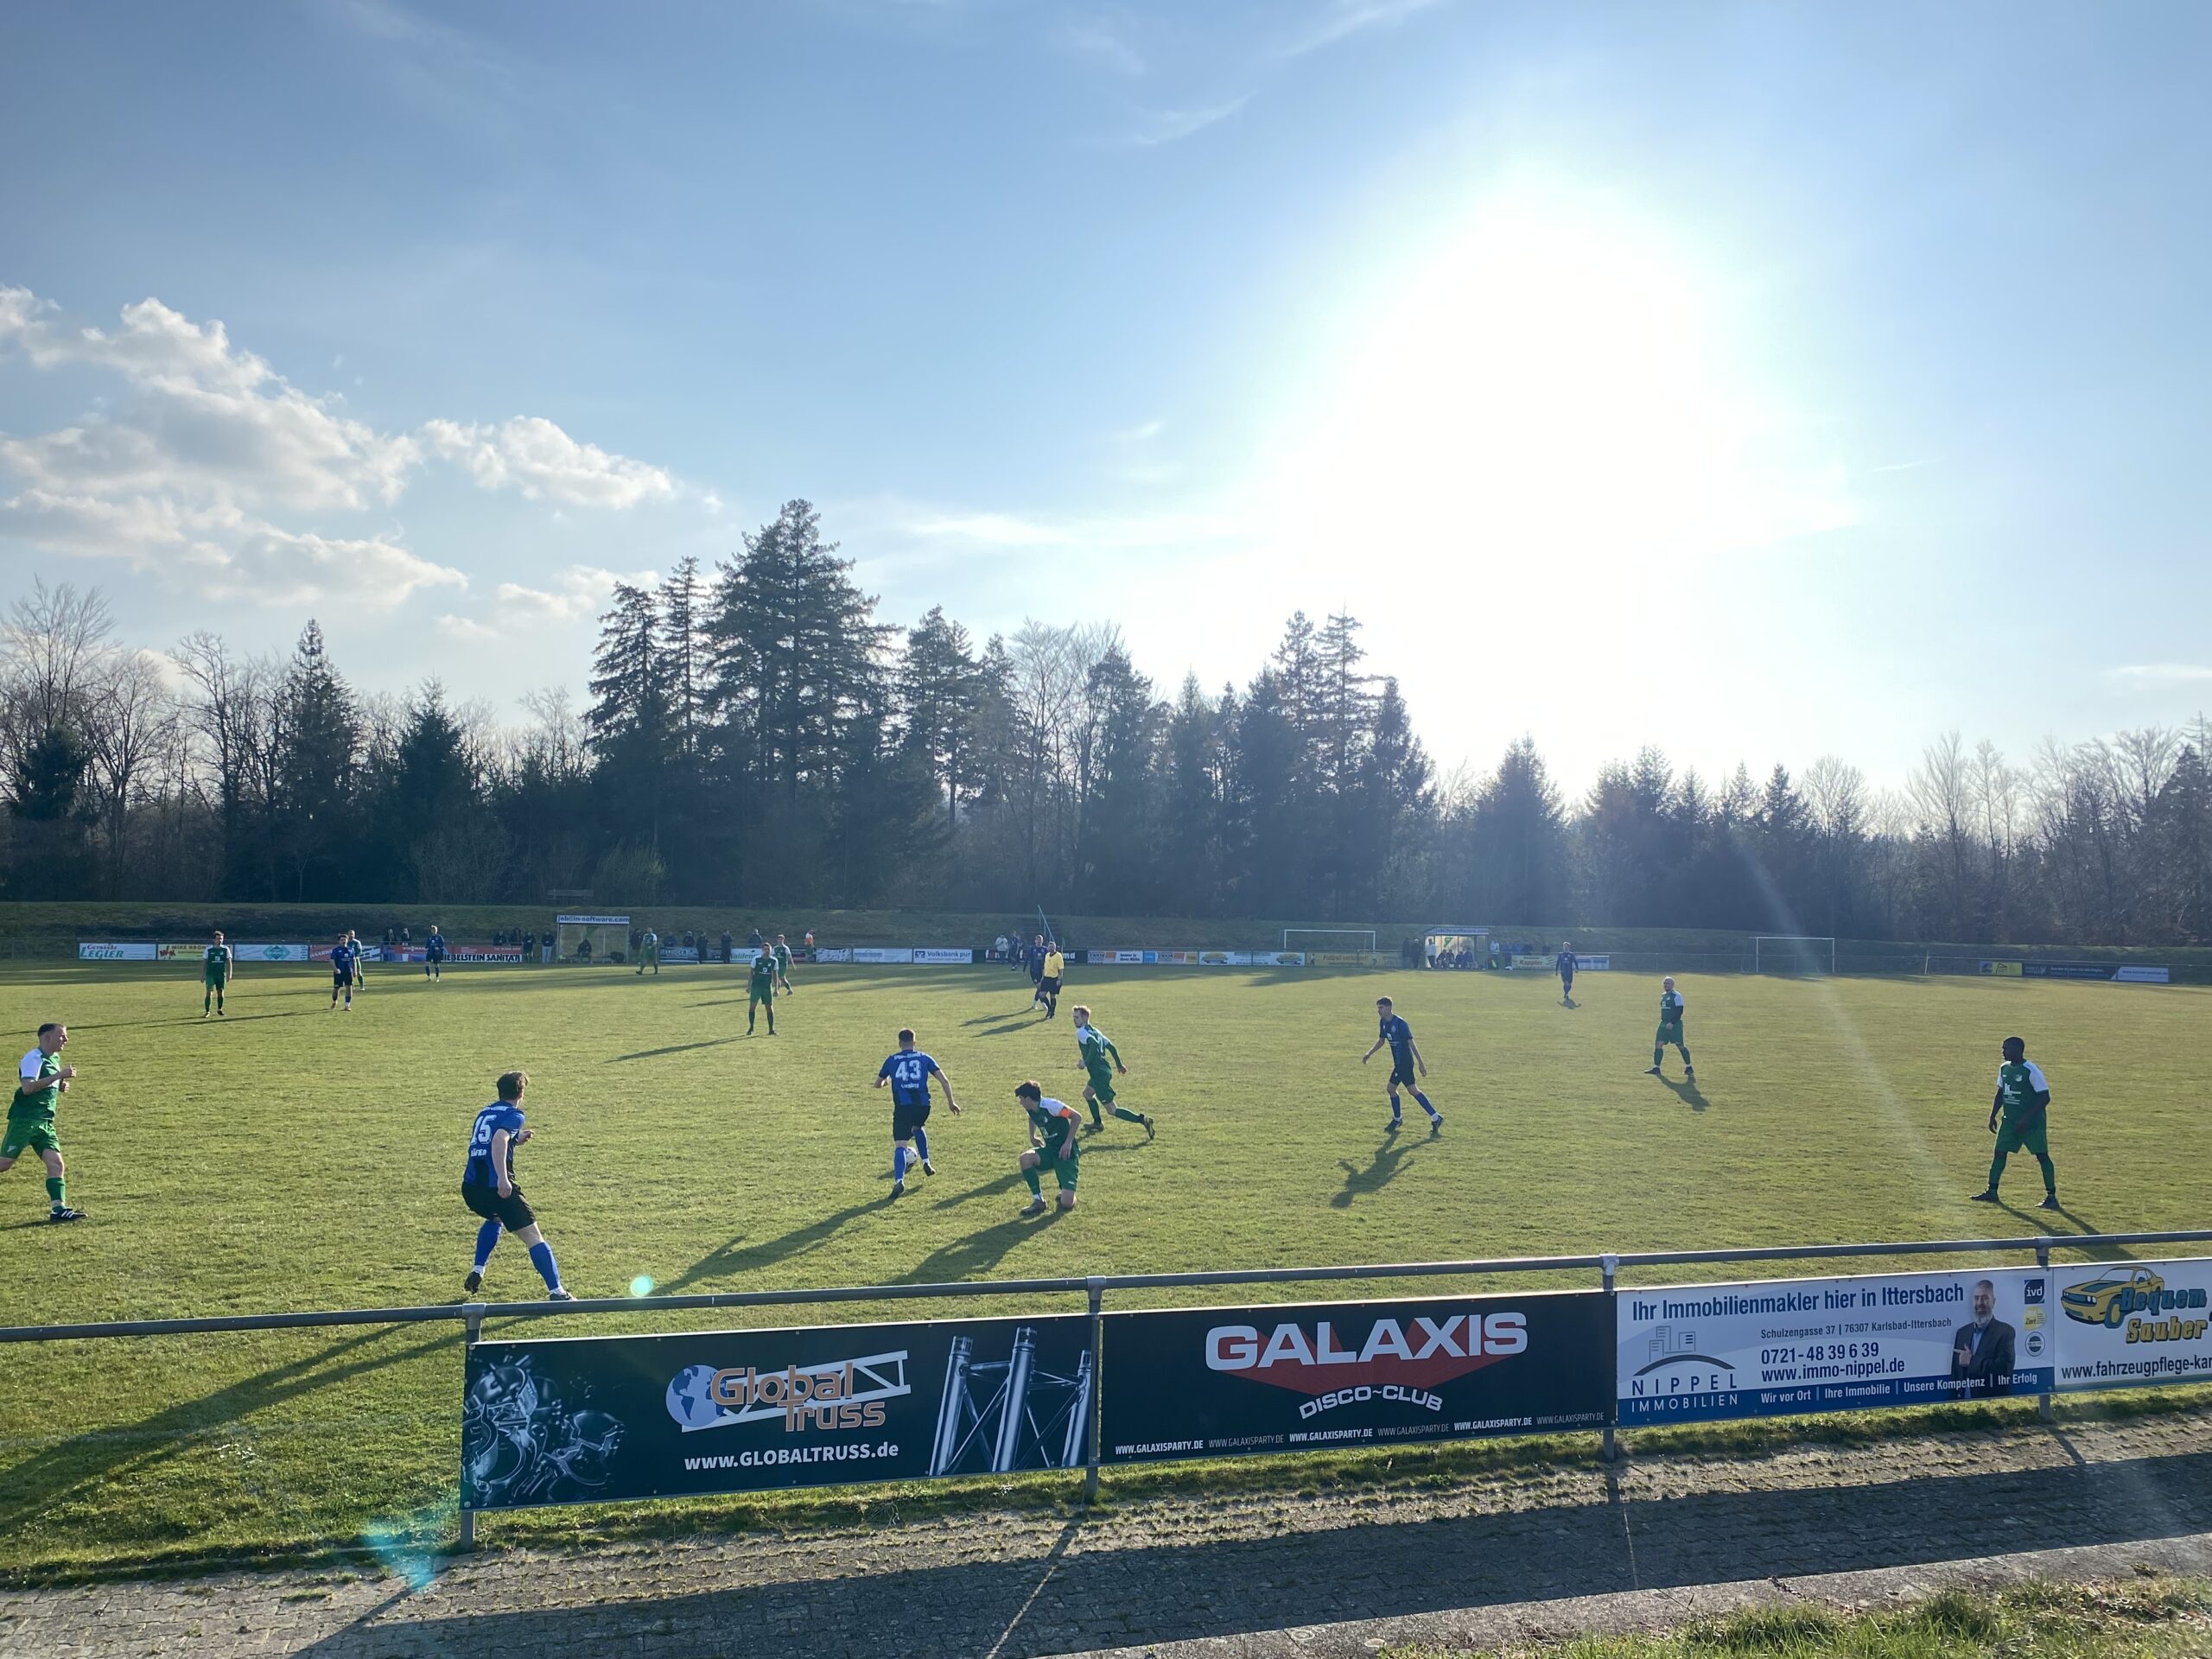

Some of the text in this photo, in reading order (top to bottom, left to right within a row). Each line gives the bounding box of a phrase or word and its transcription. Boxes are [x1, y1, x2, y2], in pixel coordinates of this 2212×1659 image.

[895, 1059, 922, 1081] 43
[470, 1115, 497, 1145] 15
[1633, 1283, 1964, 1320] Ihr Immobilienmakler hier in Ittersbach
[2026, 1286, 2043, 1297] ivd
[2120, 1286, 2208, 1316] Bequem
[1205, 1312, 1529, 1371] GALAXIS
[1761, 1317, 1952, 1338] Schulzengasse 37 76307 Karlsbad-Ittersbach
[2126, 1316, 2208, 1344] Sauber
[1828, 1344, 1845, 1360] 39
[1849, 1344, 1858, 1358] 6
[1861, 1342, 1879, 1357] 39
[710, 1363, 854, 1405] Global
[1761, 1357, 1905, 1382] www.immo-nippel.de
[1632, 1373, 1737, 1396] NIPPEL
[1761, 1373, 2037, 1403] Wir vor Ort Ihre Immobilie Unsere Kompetenz Ihr Erfolg
[777, 1399, 886, 1433] Truss
[1631, 1394, 1738, 1413] IMMOBILIEN
[1116, 1412, 1605, 1454] WWW.GALAXISPARTY.DE WWW.GALAXISPARTY.DE WWW.GALAXISPARTY.DE WWW.GALAXISPARTY.DE WWW.GALAXISPARTY.DE WWW.GALAXISPARTY.DE
[684, 1441, 899, 1470] www.GLOBALTRUSS.de
